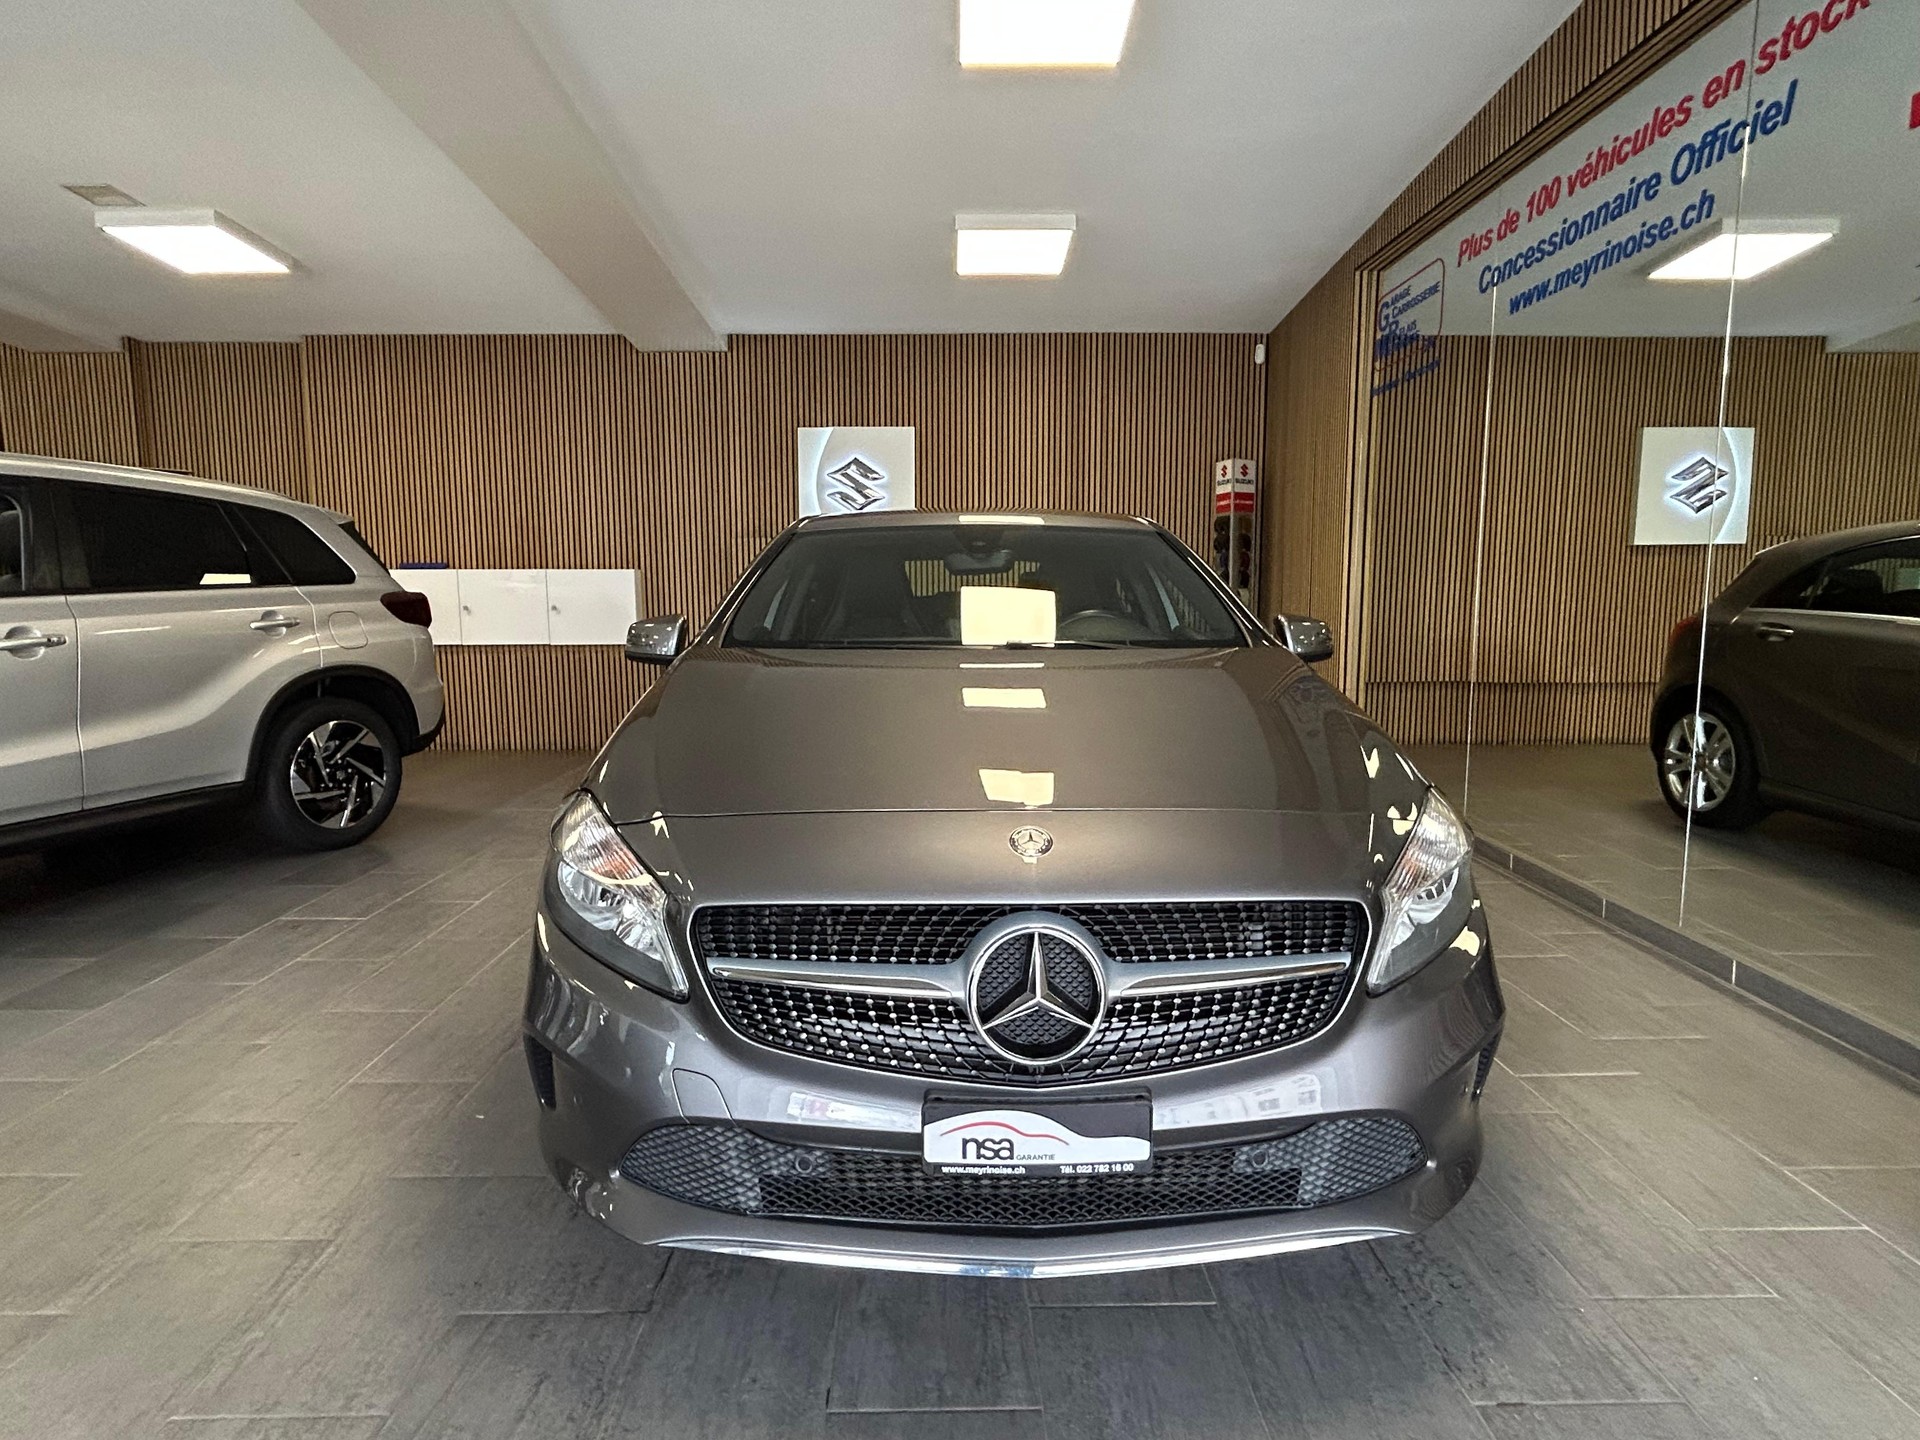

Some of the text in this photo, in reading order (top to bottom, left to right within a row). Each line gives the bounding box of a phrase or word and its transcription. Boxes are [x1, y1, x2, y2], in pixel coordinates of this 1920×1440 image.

[1457, 228, 1494, 268] Plus
[1497, 208, 1520, 241] de
[1526, 175, 1562, 223] 100
[1567, 94, 1695, 197] véhicules
[1702, 58, 1746, 109] en
[1479, 78, 1799, 294] Concessionnaire Officiel
[1508, 188, 1716, 316] www.meyrinoise.ch
[941, 1165, 1026, 1176] www.meyrinoise.ch
[961, 1137, 1056, 1161] nsa GARANTIE
[1076, 1164, 1093, 1174] 022
[1122, 1162, 1135, 1172] 00
